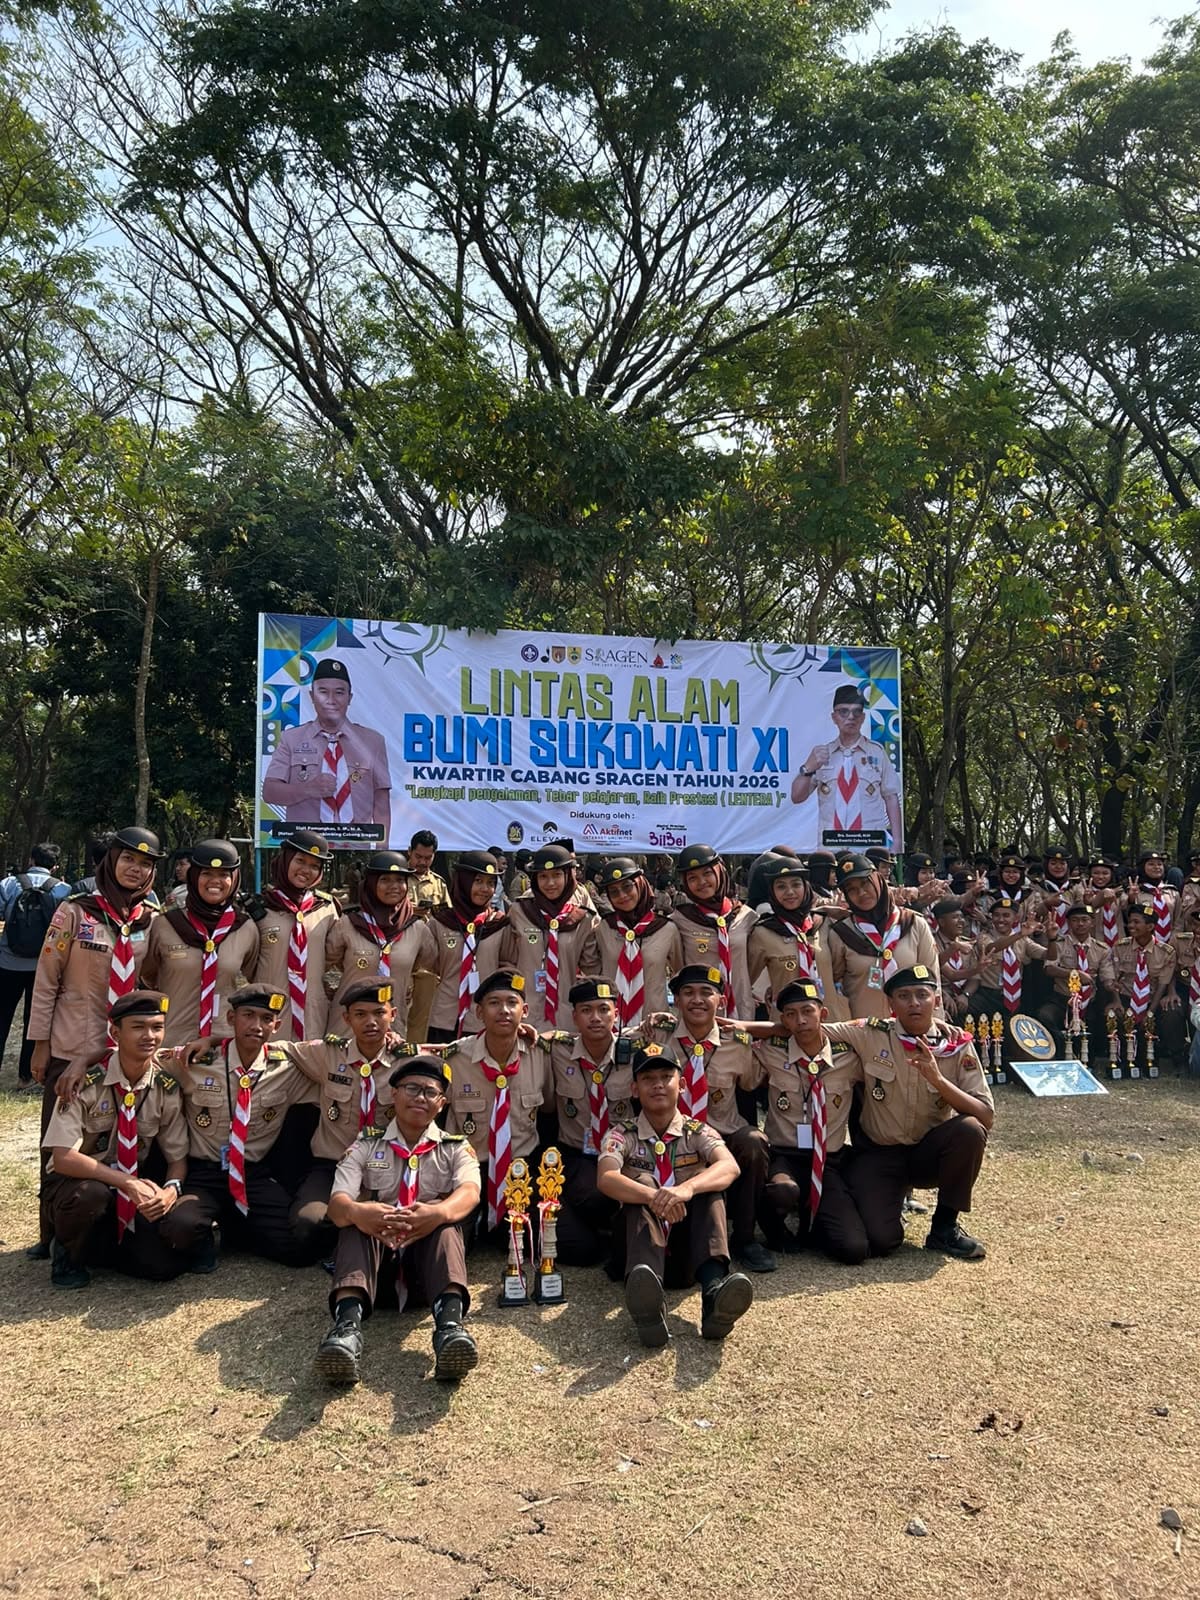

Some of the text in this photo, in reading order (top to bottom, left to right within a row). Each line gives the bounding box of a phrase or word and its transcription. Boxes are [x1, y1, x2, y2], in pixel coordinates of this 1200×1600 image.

[585, 648, 648, 664] SRAGEN
[460, 666, 740, 725] LINTAS ALAM
[404, 713, 789, 773] BUMI SUKOWATI XI
[413, 766, 779, 789] KWARTIR CABANG SRAGEN TAHUN 2026
[545, 788, 579, 803] Tebar
[669, 791, 718, 806] Prestasi
[728, 792, 773, 806] LENTERA
[570, 811, 611, 821] Didukung
[613, 811, 631, 820] oleh
[600, 827, 633, 836] Aktifnet
[649, 831, 686, 847] BilBel
